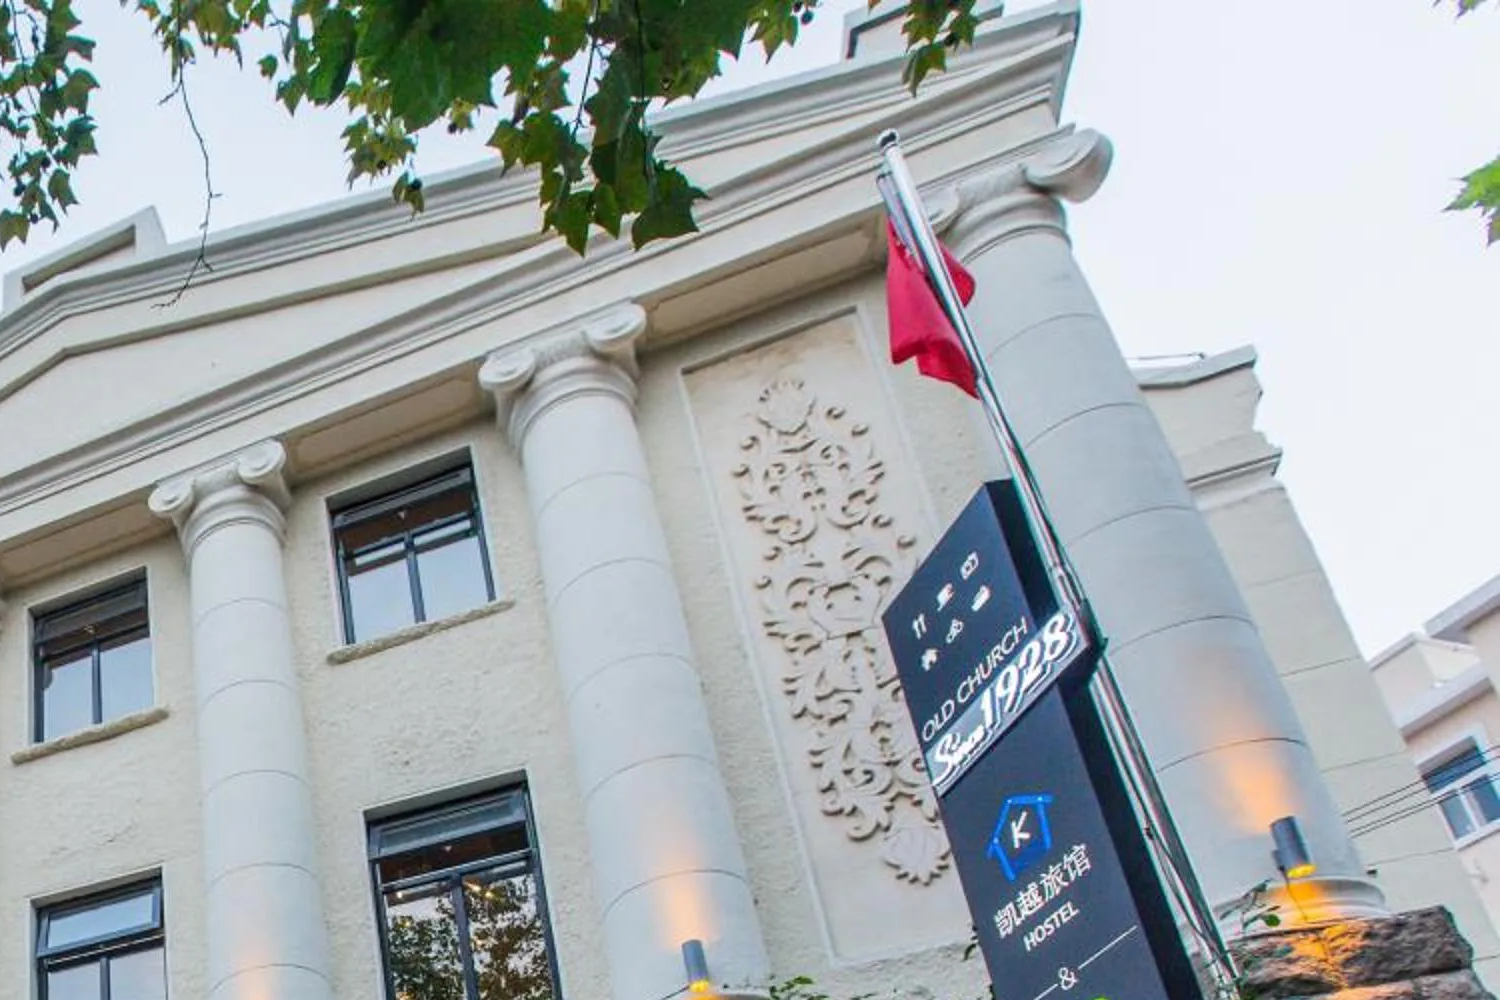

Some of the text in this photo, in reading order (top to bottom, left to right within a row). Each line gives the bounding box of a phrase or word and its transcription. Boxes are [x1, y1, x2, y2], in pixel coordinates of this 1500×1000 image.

[922, 615, 1029, 742] OLD CHURCH
[931, 612, 1077, 788] Since 1928
[1011, 811, 1032, 849] K
[993, 843, 1093, 940] 凯越旅馆
[1022, 900, 1080, 953] HOSTEL
[1057, 966, 1079, 991] &
